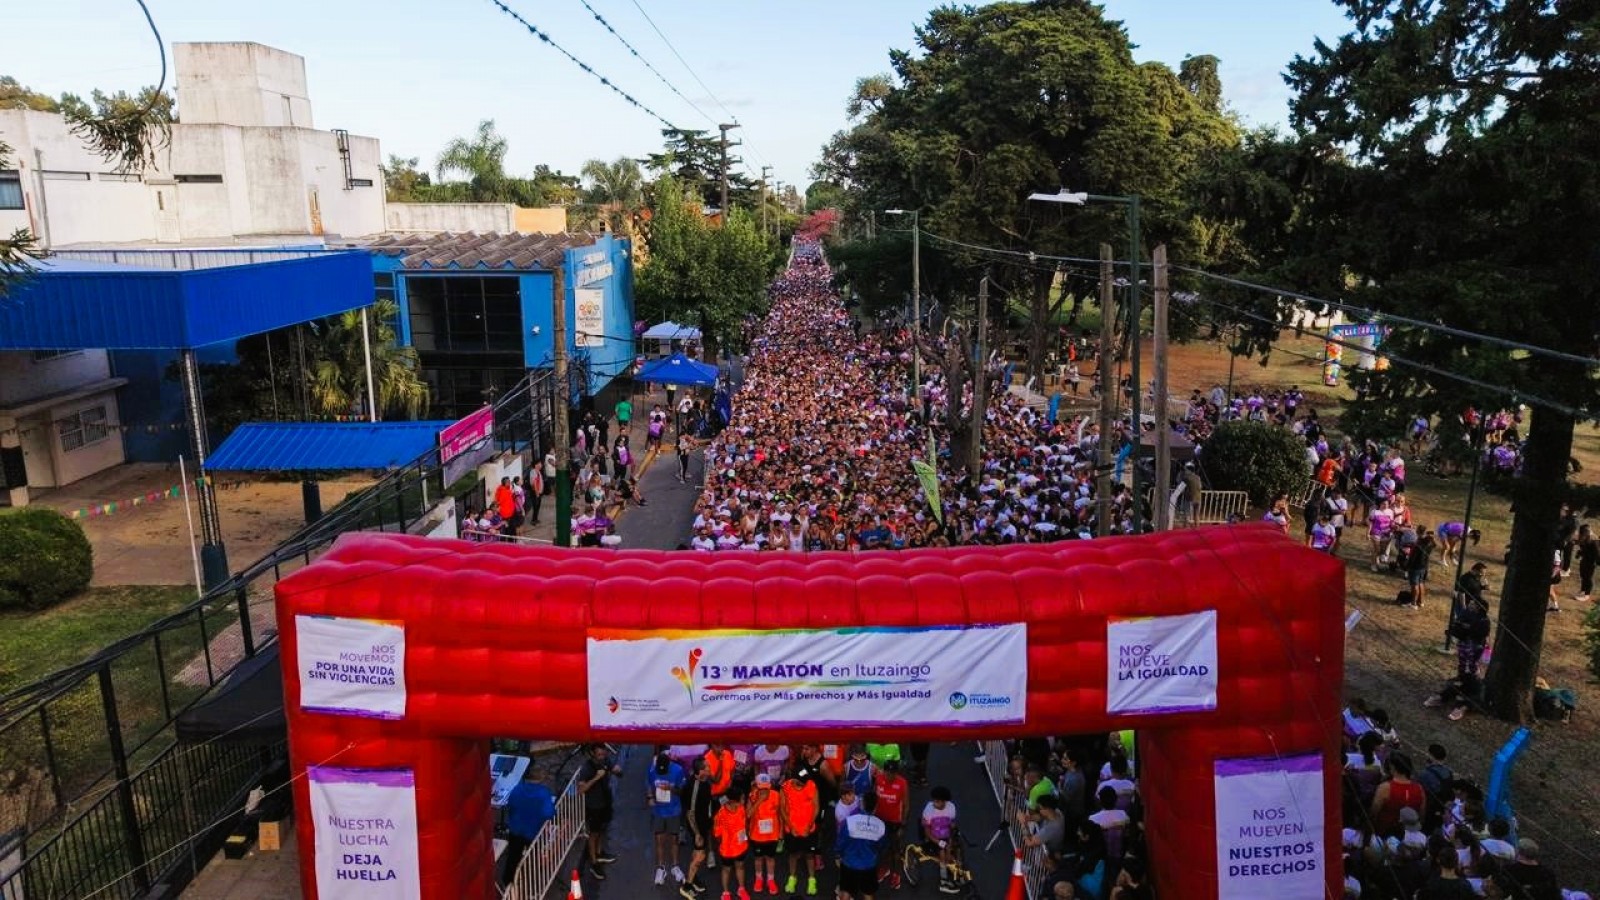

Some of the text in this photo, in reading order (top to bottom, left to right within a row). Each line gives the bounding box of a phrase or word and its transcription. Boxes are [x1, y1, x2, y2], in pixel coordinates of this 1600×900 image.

[372, 645, 395, 654] NOS
[1120, 644, 1151, 656] NOS
[340, 653, 395, 664] MOVEMOS
[1120, 655, 1170, 668] MUEVE
[316, 662, 395, 676] POR UNA VIDA
[732, 661, 823, 679] MARATÓN
[831, 665, 850, 677] en
[856, 661, 931, 679] Ituzaingó
[1119, 665, 1209, 681] LA IGUALDAD
[308, 670, 395, 685] SIN VIOLENCIAS
[701, 690, 931, 702] Corremos Por Más Derechos y Más Igualdad
[1253, 807, 1286, 820] NOS
[329, 814, 395, 830] NUESTRA
[1240, 822, 1303, 838] MUEVEN
[339, 833, 389, 846] LUCHA
[1230, 842, 1314, 860] NUESTROS
[343, 854, 382, 866] DEJA
[1230, 860, 1316, 877] DERECHOS
[337, 869, 397, 882] HUELLA
